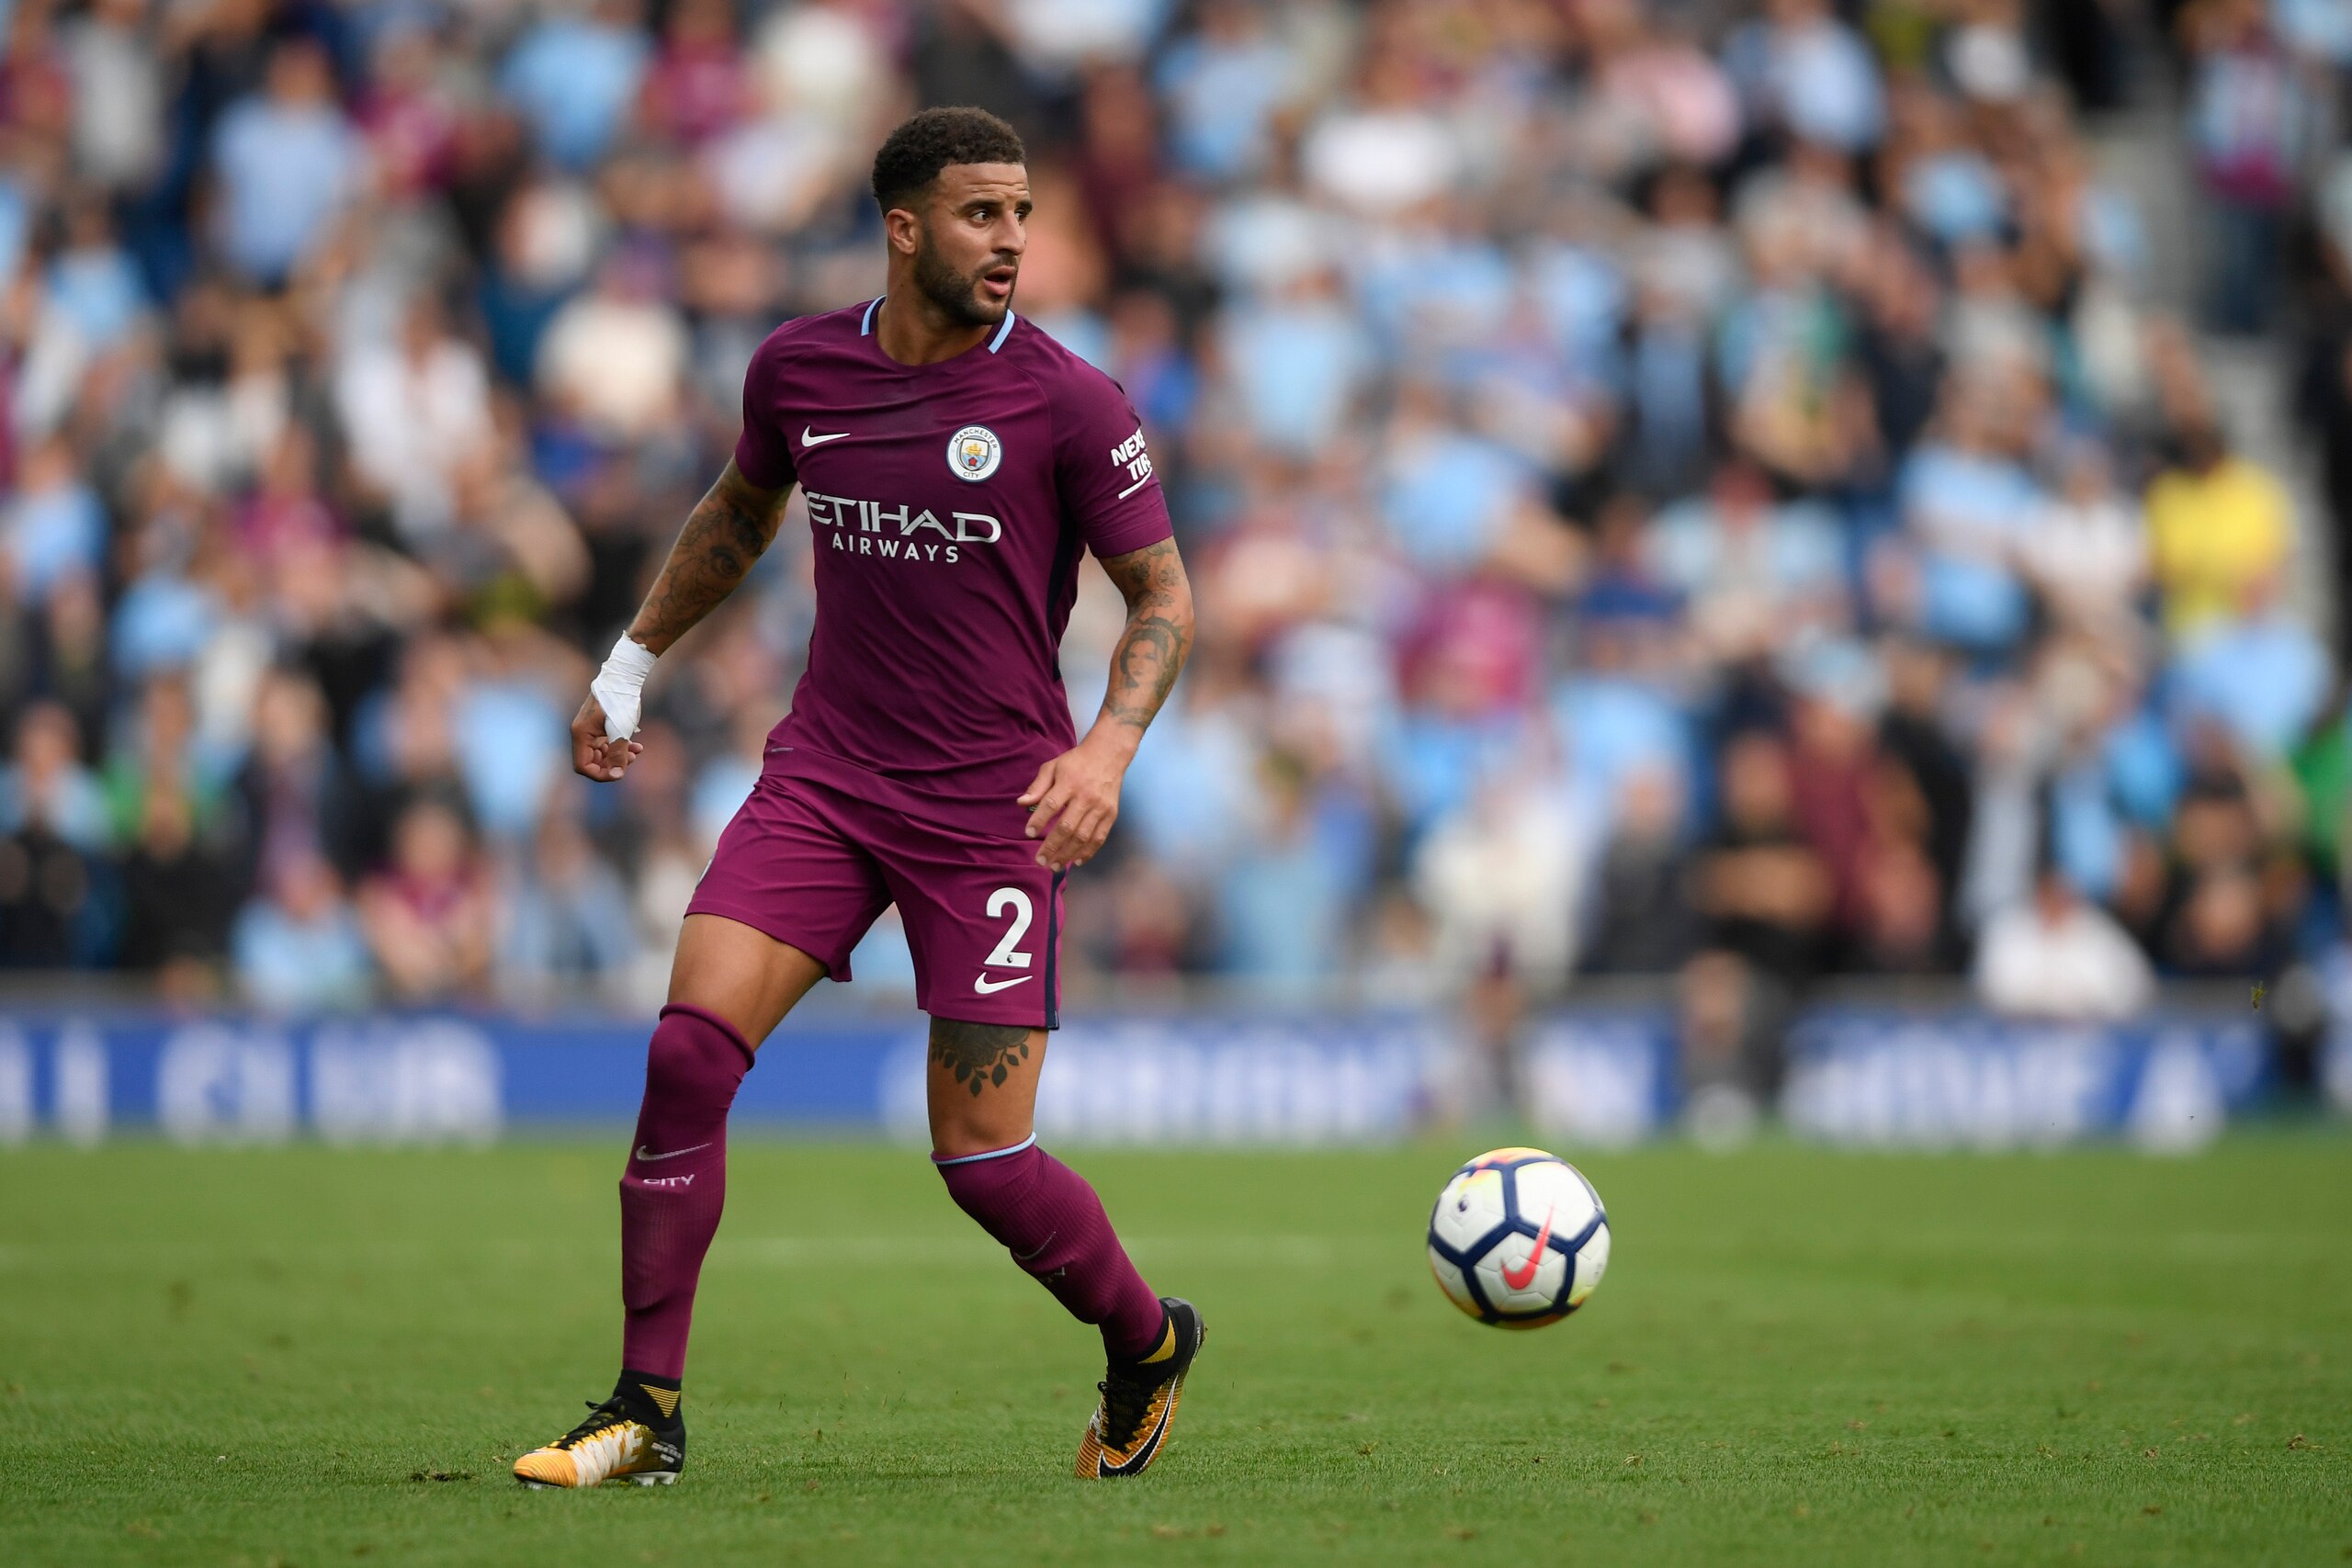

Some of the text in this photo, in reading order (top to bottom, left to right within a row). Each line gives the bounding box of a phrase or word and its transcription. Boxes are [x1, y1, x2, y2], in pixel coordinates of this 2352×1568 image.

[954, 428, 998, 449] MANCHESTER
[1110, 427, 1146, 467] NEX
[1126, 452, 1151, 480] TIR
[806, 491, 1002, 544] ETIHAD
[831, 532, 959, 563] AIRWAYS
[984, 886, 1034, 968] 2
[642, 1173, 695, 1187] CITY
